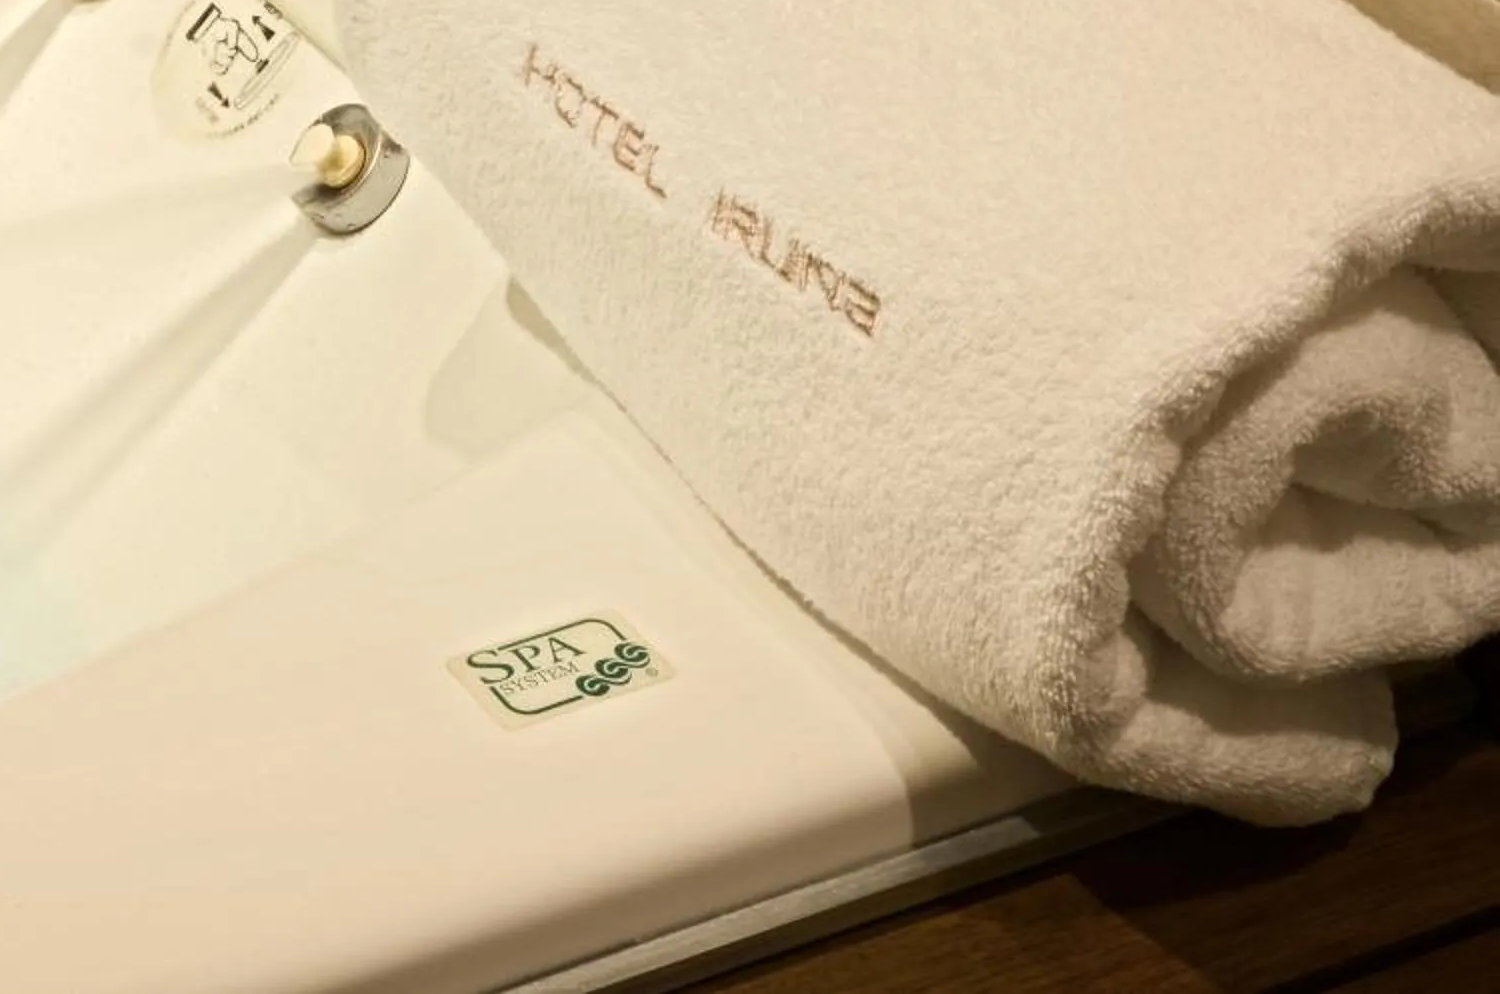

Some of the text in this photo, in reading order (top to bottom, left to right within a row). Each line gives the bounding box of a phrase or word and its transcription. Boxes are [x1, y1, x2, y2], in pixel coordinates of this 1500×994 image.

[519, 43, 668, 200] HOTEL
[466, 636, 588, 685] SPA
[500, 660, 581, 696] SYSTEM
